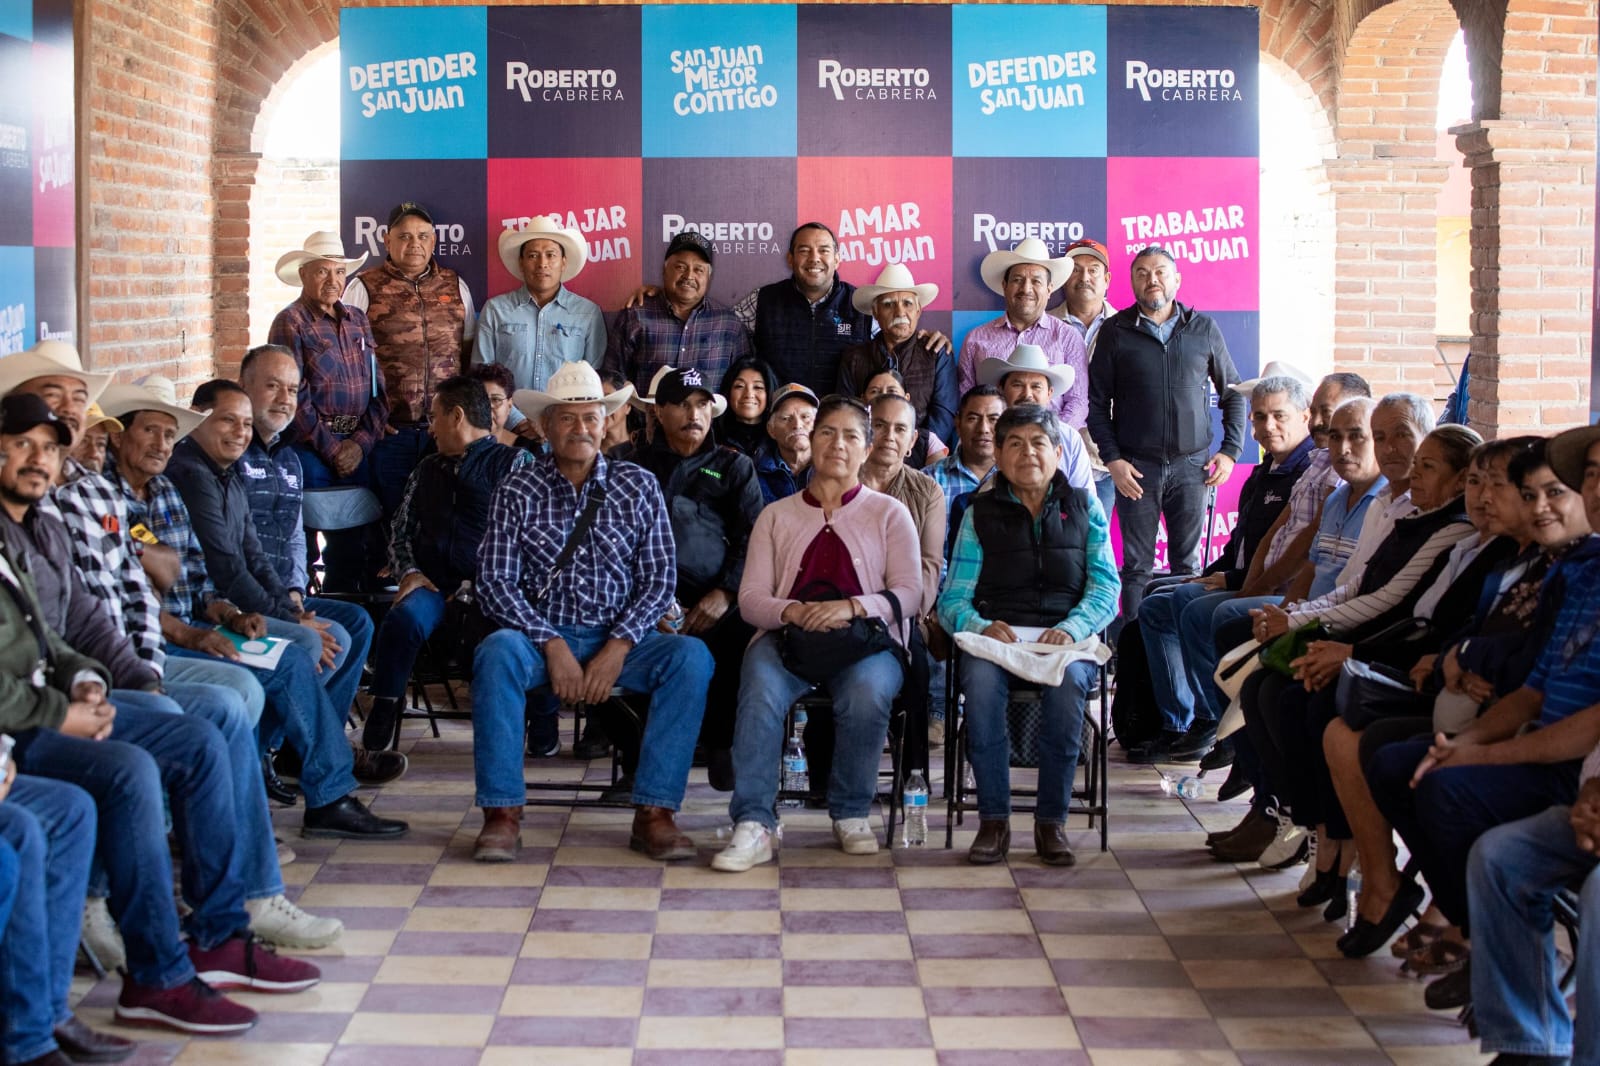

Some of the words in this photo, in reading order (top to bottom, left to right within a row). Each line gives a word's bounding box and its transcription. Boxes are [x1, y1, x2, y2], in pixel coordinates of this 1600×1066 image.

[349, 51, 477, 92] DEFENDER
[506, 61, 617, 102] ROBERTO
[684, 65, 758, 93] MEJOR
[818, 60, 930, 101] ROBERTO
[967, 50, 1097, 88] DEFENDER
[1126, 60, 1235, 101] ROBERTO
[542, 89, 624, 101] CABRERA
[673, 85, 778, 116] CONTIGO
[855, 88, 937, 100] CABRERA
[1162, 89, 1242, 101] CABRERA
[355, 216, 465, 256] ROTO
[501, 205, 627, 233] TRBAJAR
[838, 202, 921, 238] AMAR
[973, 213, 1084, 253] ROBERTO
[1121, 205, 1244, 240] TRABAJAR
[711, 242, 780, 254] ABRERA
